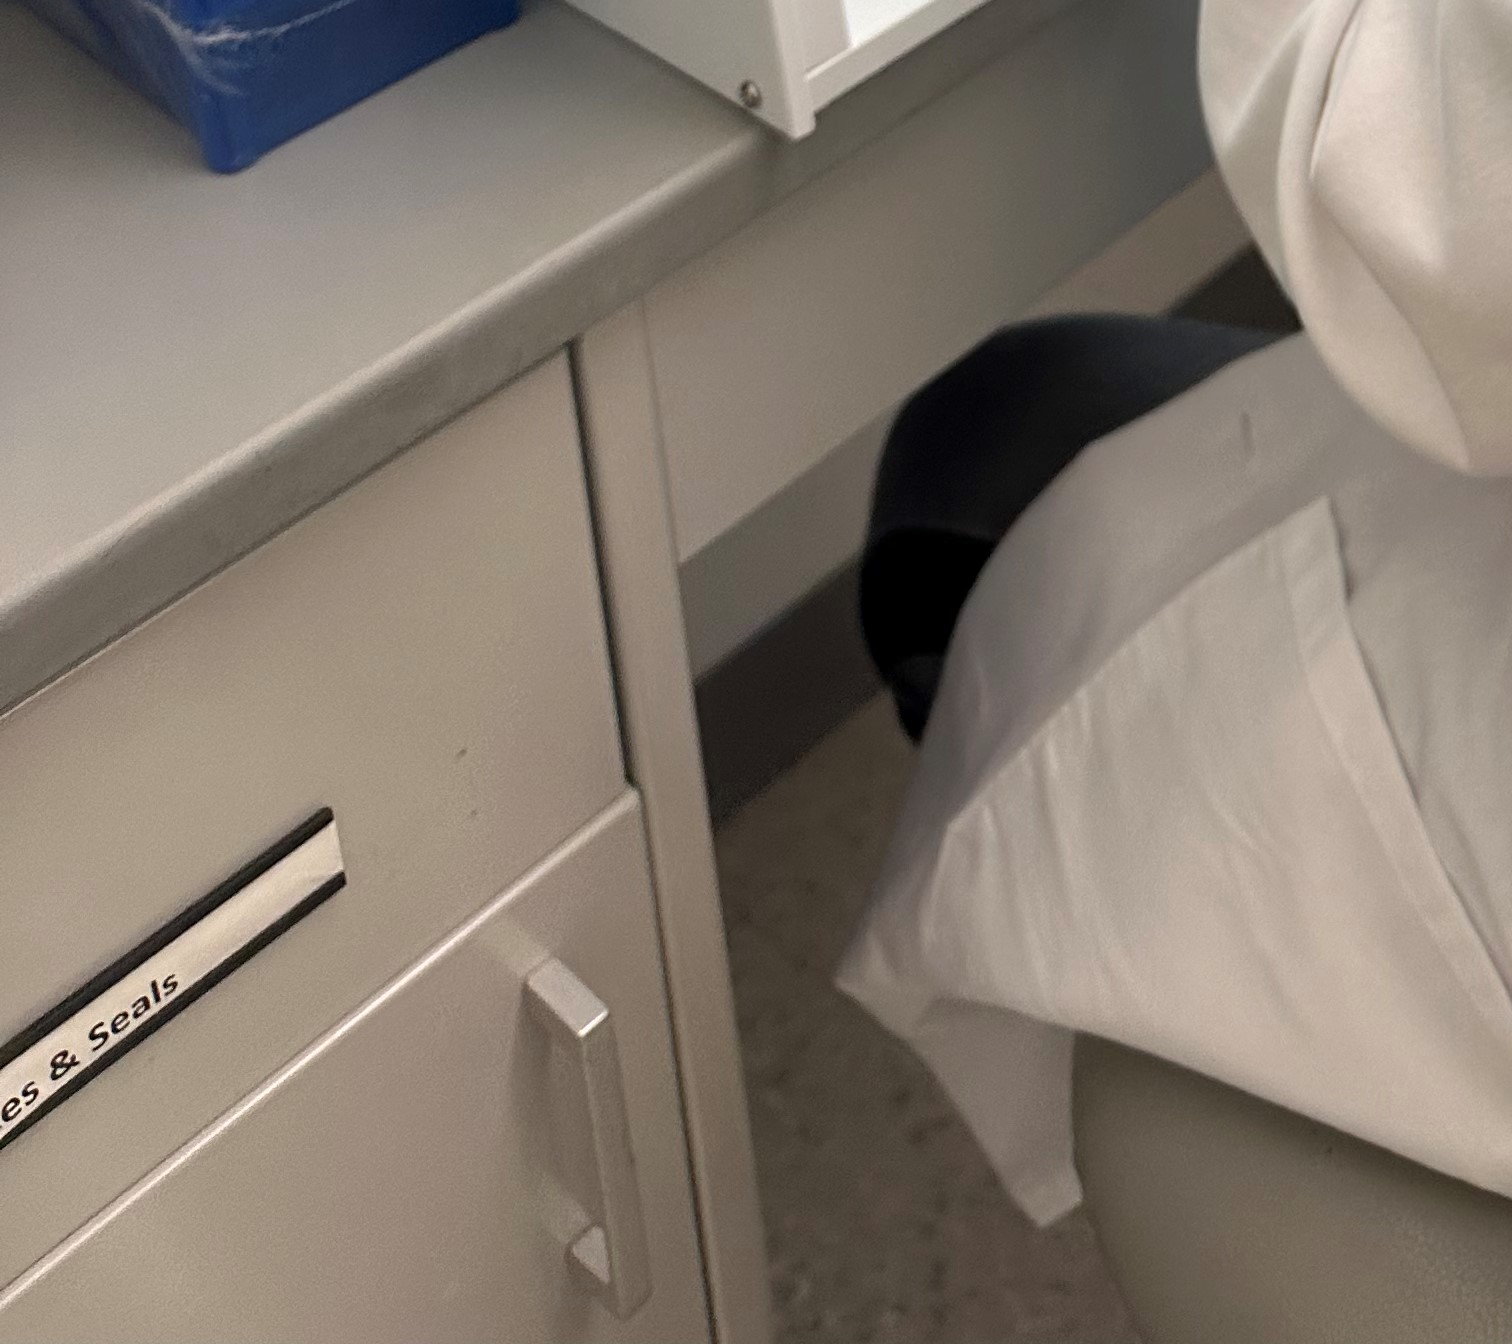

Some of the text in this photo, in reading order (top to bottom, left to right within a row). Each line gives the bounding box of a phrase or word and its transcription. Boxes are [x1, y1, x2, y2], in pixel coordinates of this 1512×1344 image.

[0, 973, 179, 1128] es & Seals
